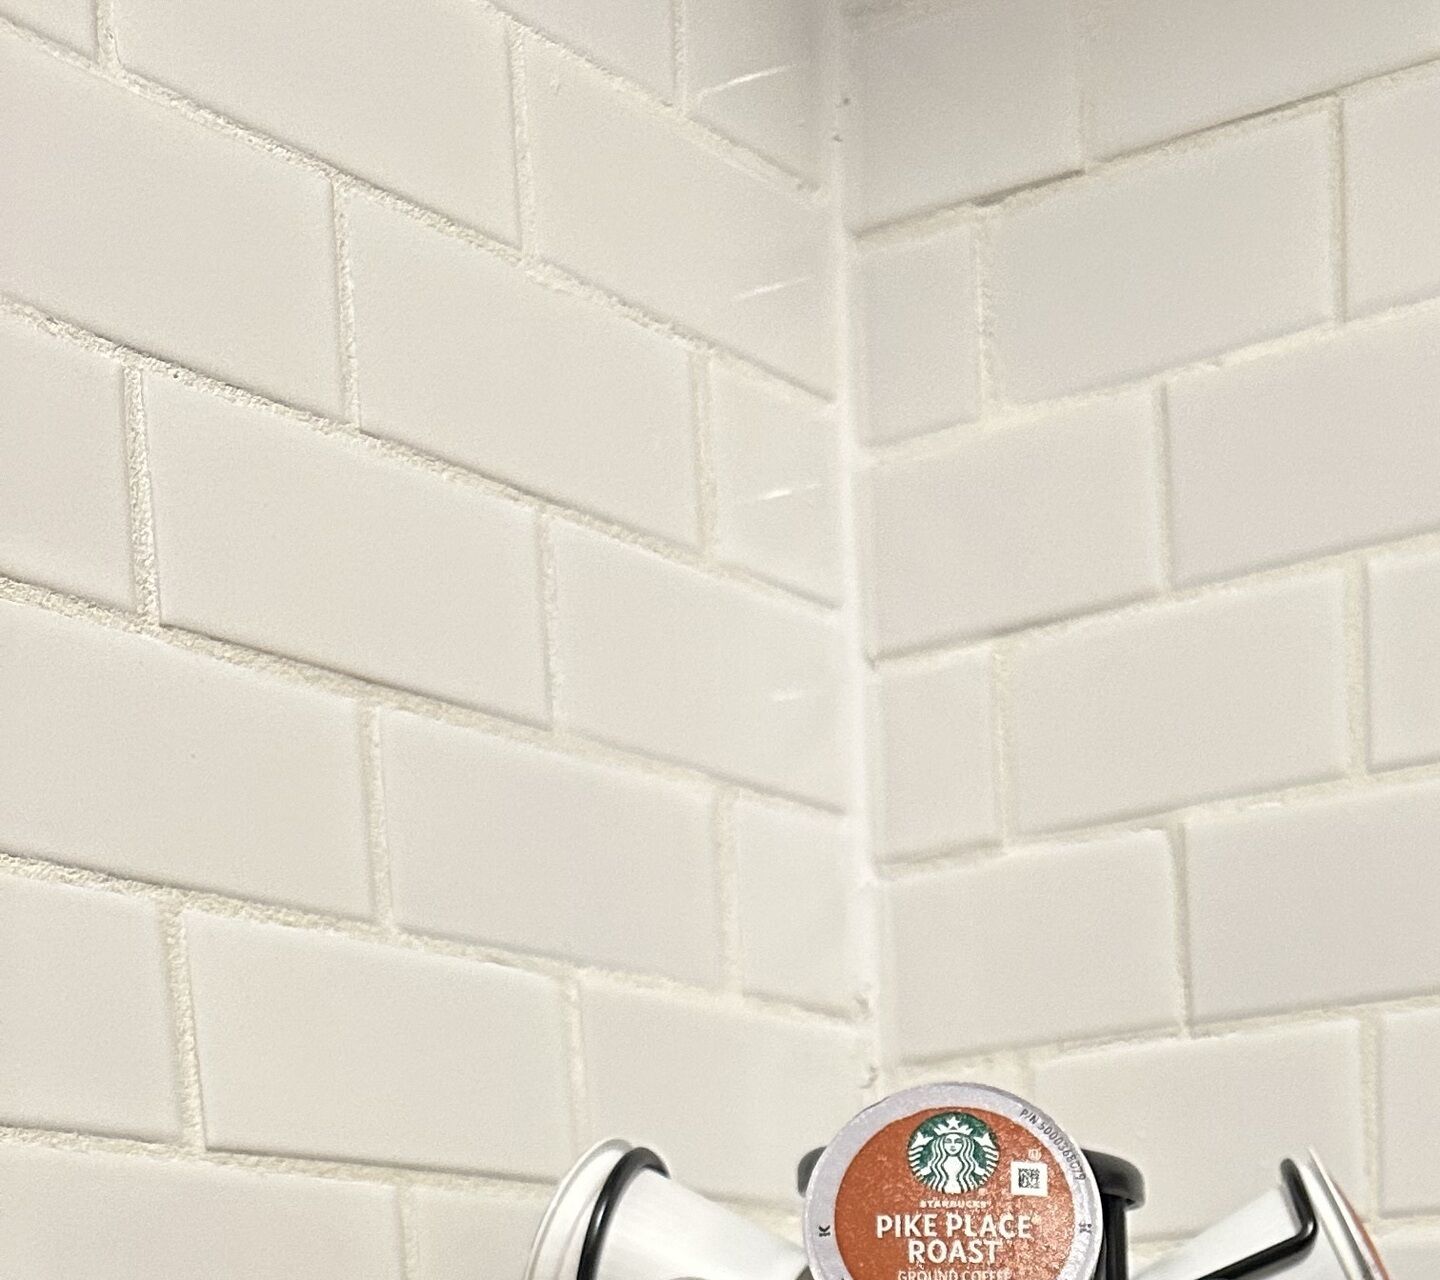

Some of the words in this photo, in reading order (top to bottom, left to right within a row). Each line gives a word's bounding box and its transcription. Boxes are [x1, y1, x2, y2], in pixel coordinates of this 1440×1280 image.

[920, 1201, 987, 1209] STARBUCKS
[876, 1214, 938, 1239] PIKE
[946, 1216, 1031, 1239] PLACE
[908, 1240, 1002, 1264] ROAST
